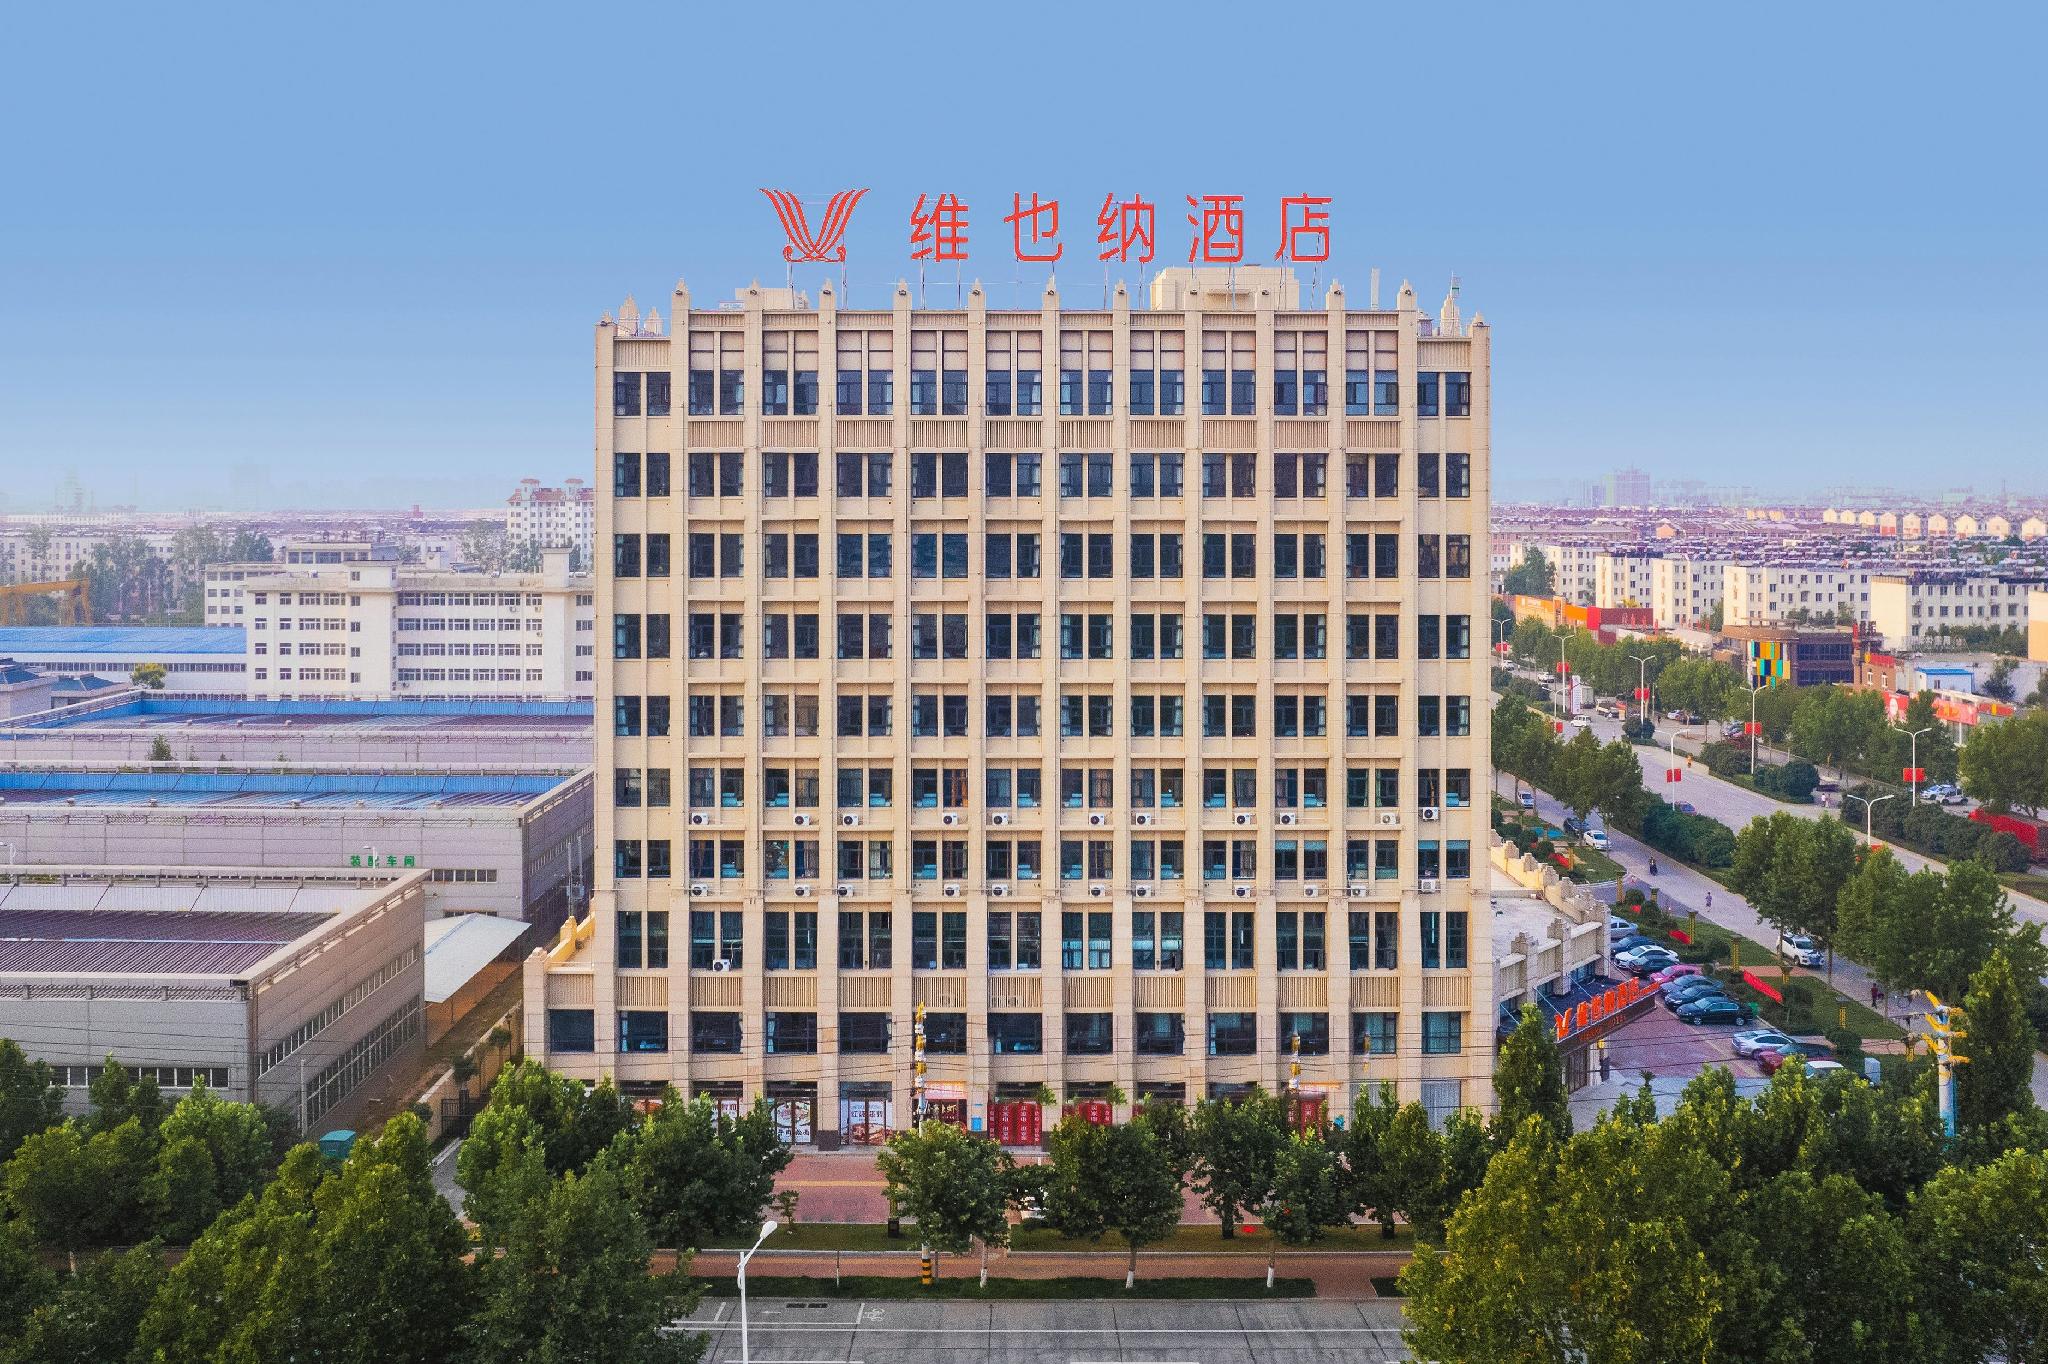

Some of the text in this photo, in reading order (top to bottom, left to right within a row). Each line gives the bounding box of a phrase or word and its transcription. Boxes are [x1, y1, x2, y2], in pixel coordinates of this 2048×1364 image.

[910, 193, 1332, 263] 维也纳酒店
[350, 855, 416, 867] 装配车间
